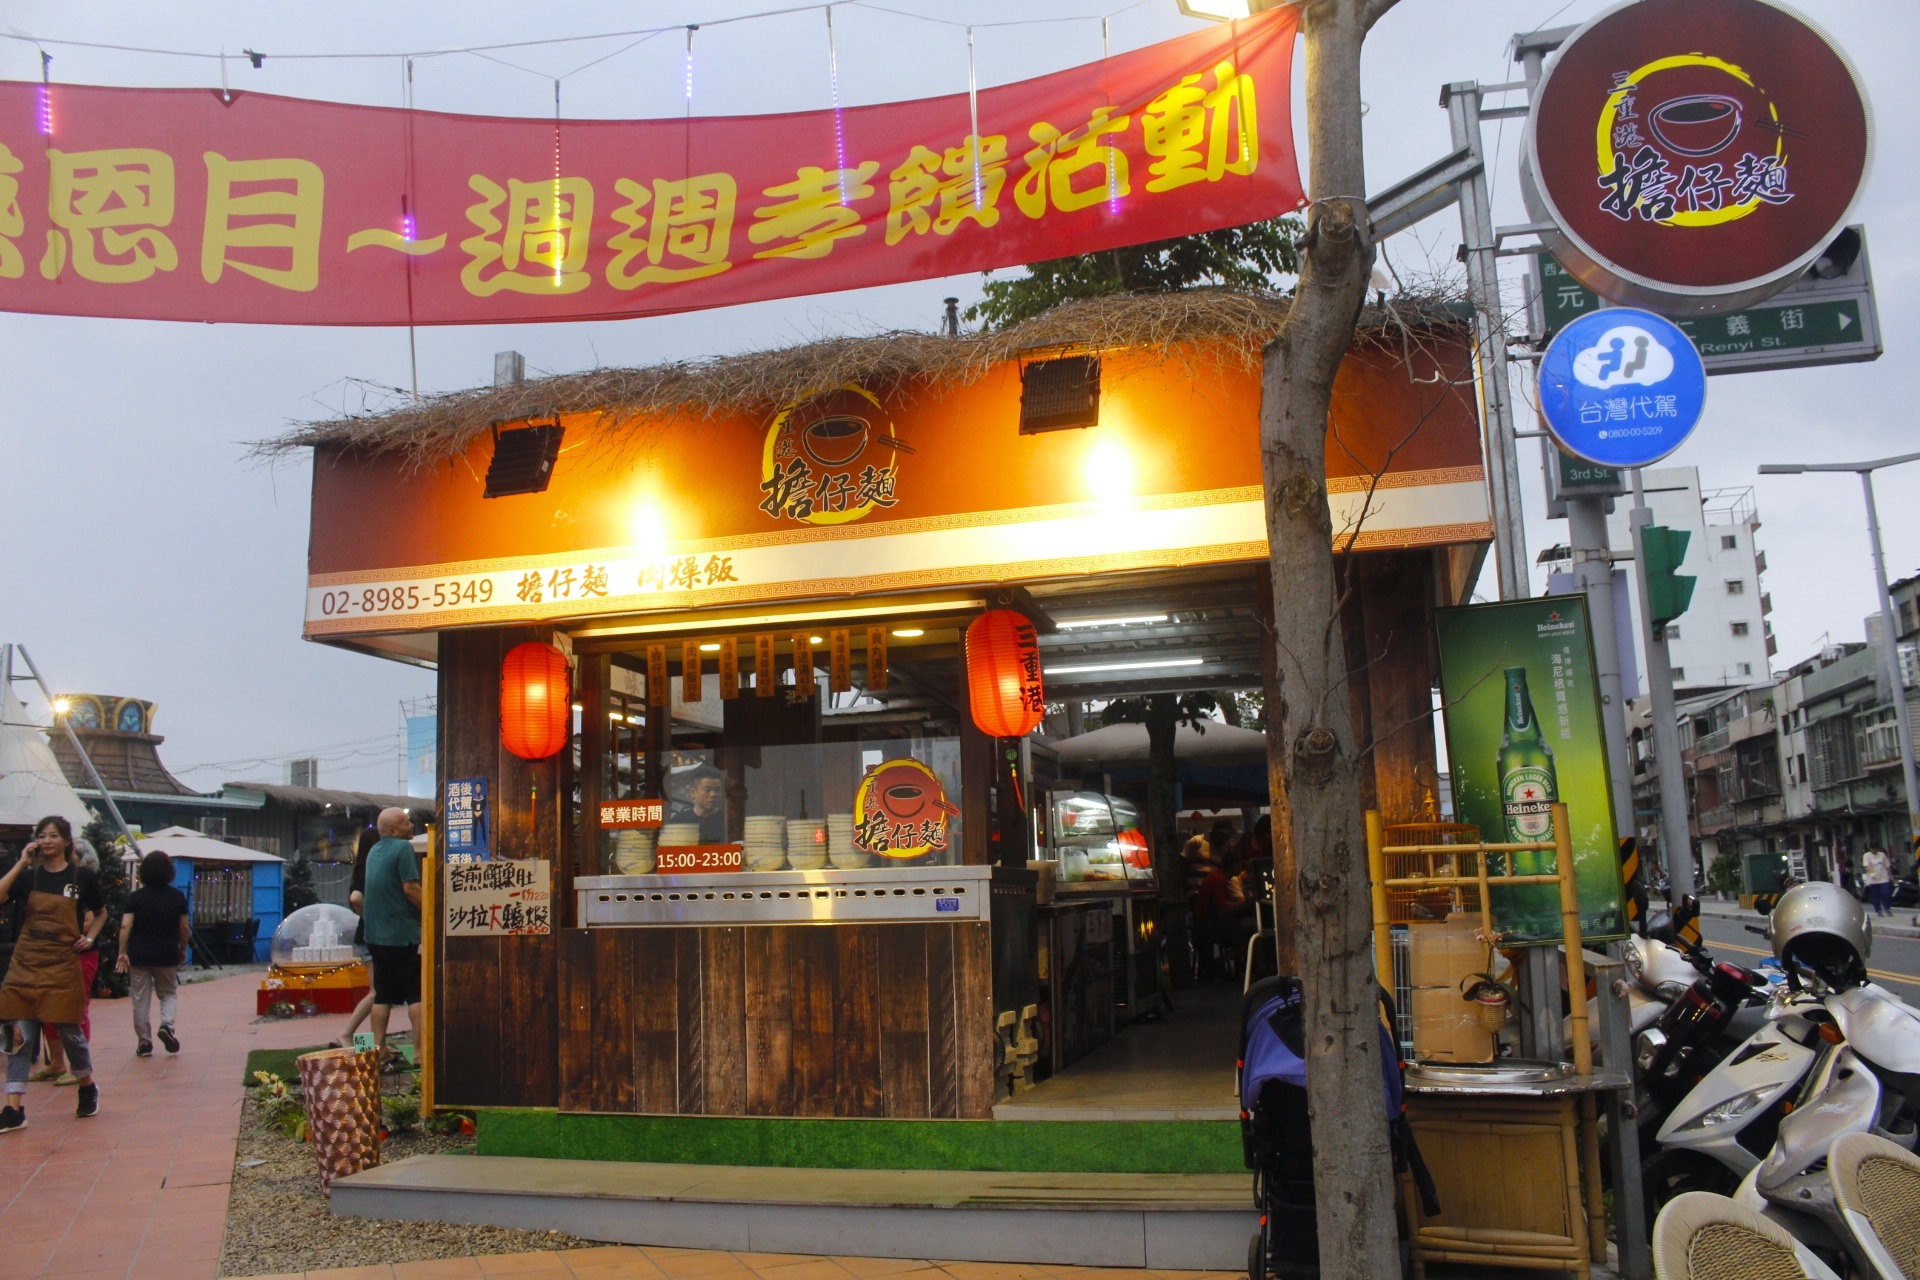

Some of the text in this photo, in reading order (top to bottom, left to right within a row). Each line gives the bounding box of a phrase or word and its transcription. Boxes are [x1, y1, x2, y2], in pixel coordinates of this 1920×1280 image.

[1607, 71, 1645, 148] 三重港
[0, 60, 1258, 296] 恩月～週週孝饋活動
[1597, 145, 1795, 221] 擔仔麵
[1544, 262, 1557, 276] 西
[1701, 337, 1786, 353] Renyi St.
[1579, 394, 1677, 424] 台灣代駕
[1608, 426, 1663, 438] 0800-00-5209
[1570, 468, 1591, 480] 3rd
[1594, 467, 1611, 479] St.
[759, 456, 900, 520] 擔仔麵
[322, 554, 739, 616] 02-8985-5349 擔仔麵 肉燥飯
[1537, 621, 1575, 632] Heineken
[1016, 624, 1043, 713] 三重港
[448, 782, 472, 797] 酒後
[600, 805, 663, 824] 營業時間
[1506, 802, 1553, 815] Heineke
[853, 811, 948, 852] 擔仔麵
[657, 852, 741, 868] 15:00-23:00
[1553, 917, 1616, 933] 安有保障
